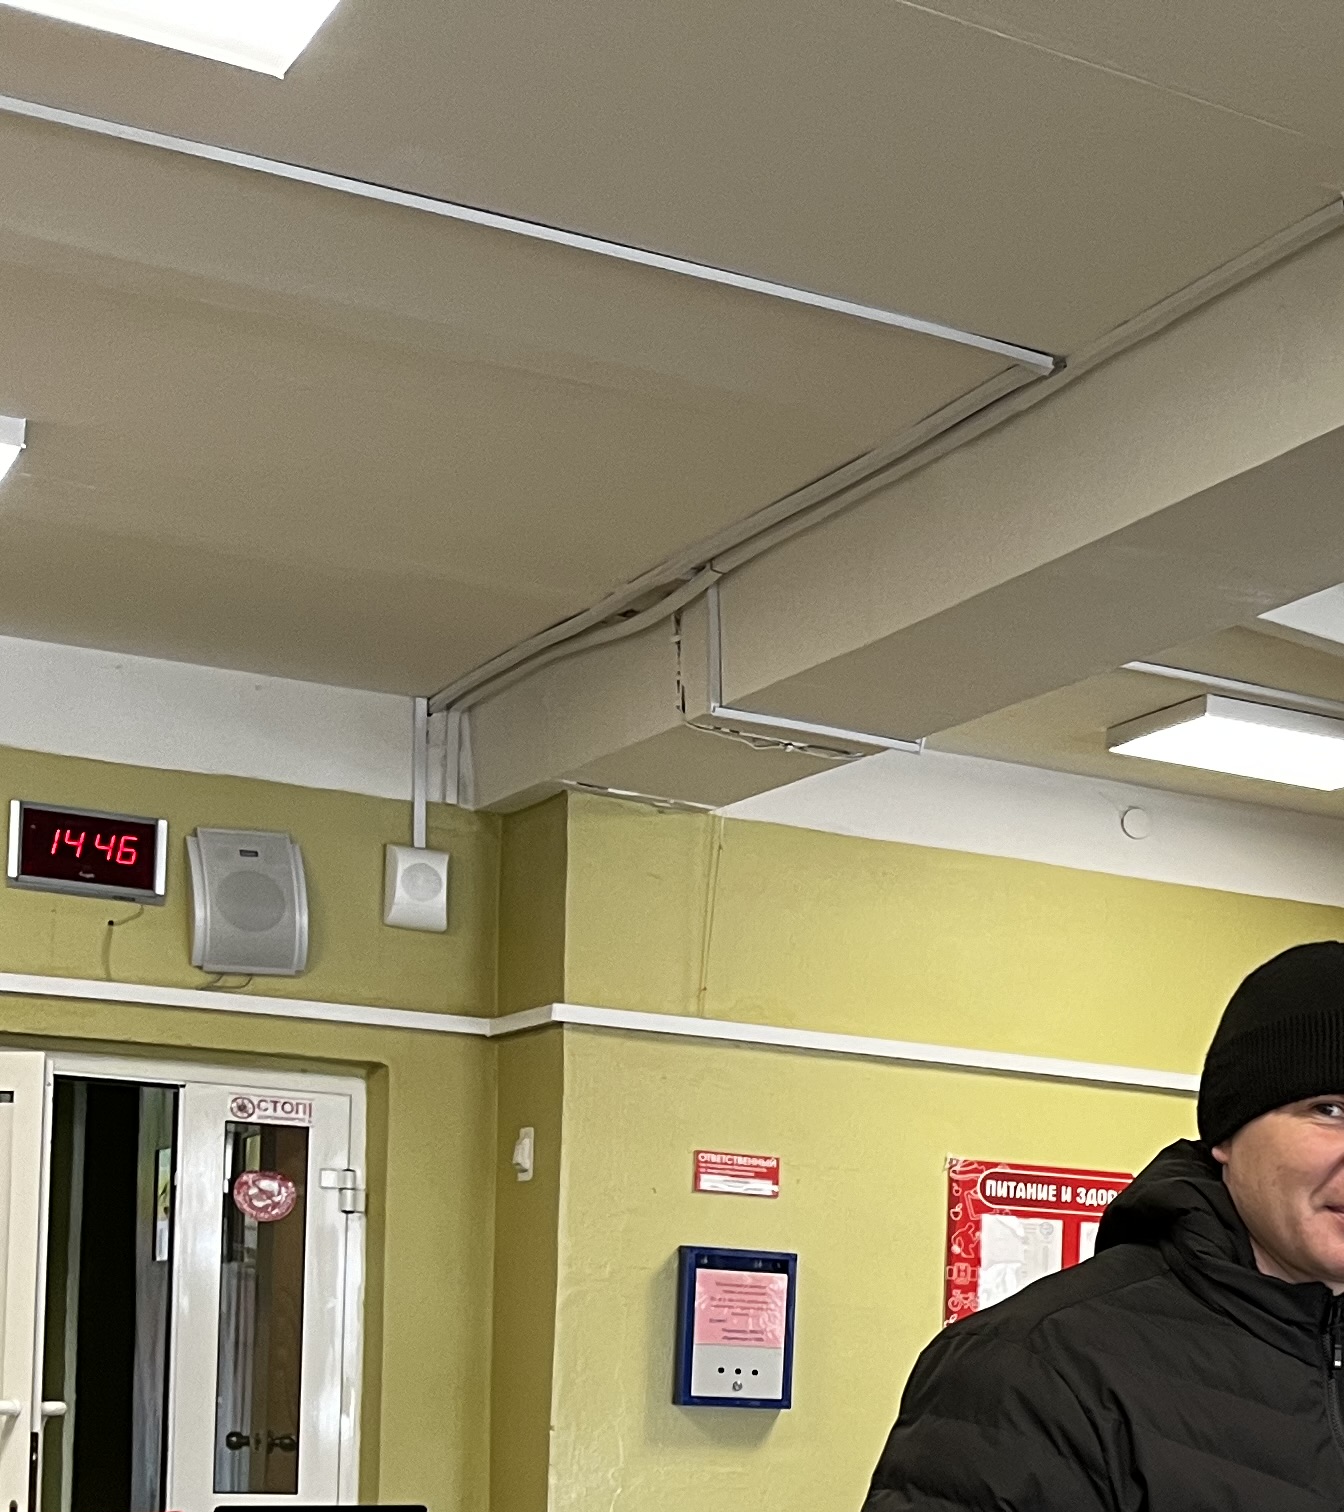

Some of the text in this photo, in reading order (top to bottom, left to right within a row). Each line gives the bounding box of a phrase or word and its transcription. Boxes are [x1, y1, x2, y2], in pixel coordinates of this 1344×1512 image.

[257, 1099, 313, 1123] СТОП!
[698, 1152, 777, 1168] ОТВЕТСТВЕННЫЙ
[985, 1179, 1057, 1202] ПИТАНИЕ
[1061, 1185, 1072, 1203] И
